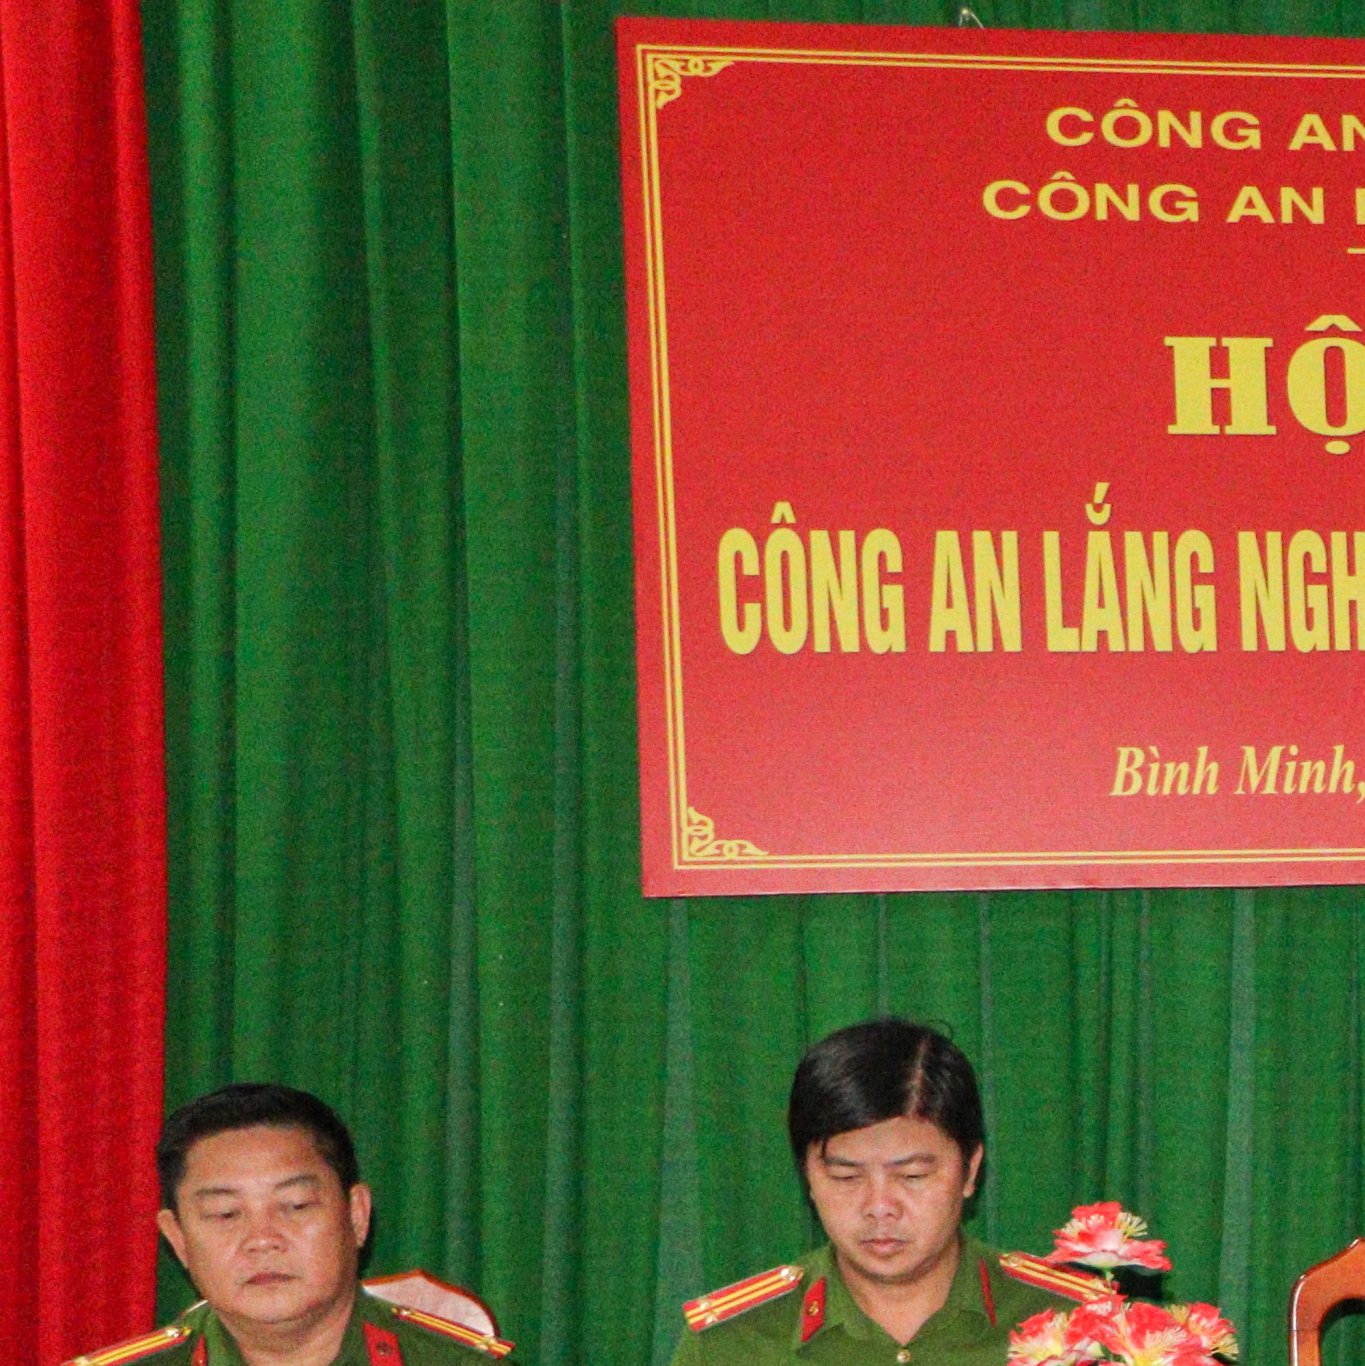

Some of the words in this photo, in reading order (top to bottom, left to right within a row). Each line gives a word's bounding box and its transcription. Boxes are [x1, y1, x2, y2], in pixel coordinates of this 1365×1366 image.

[1046, 97, 1260, 150] CÔNG
[982, 170, 1199, 223] CÔNG
[1226, 185, 1325, 225] AN
[717, 500, 907, 656] CÔNG
[927, 529, 1023, 653] AN
[1042, 481, 1218, 654] LẮNG
[1108, 744, 1221, 798] Bình
